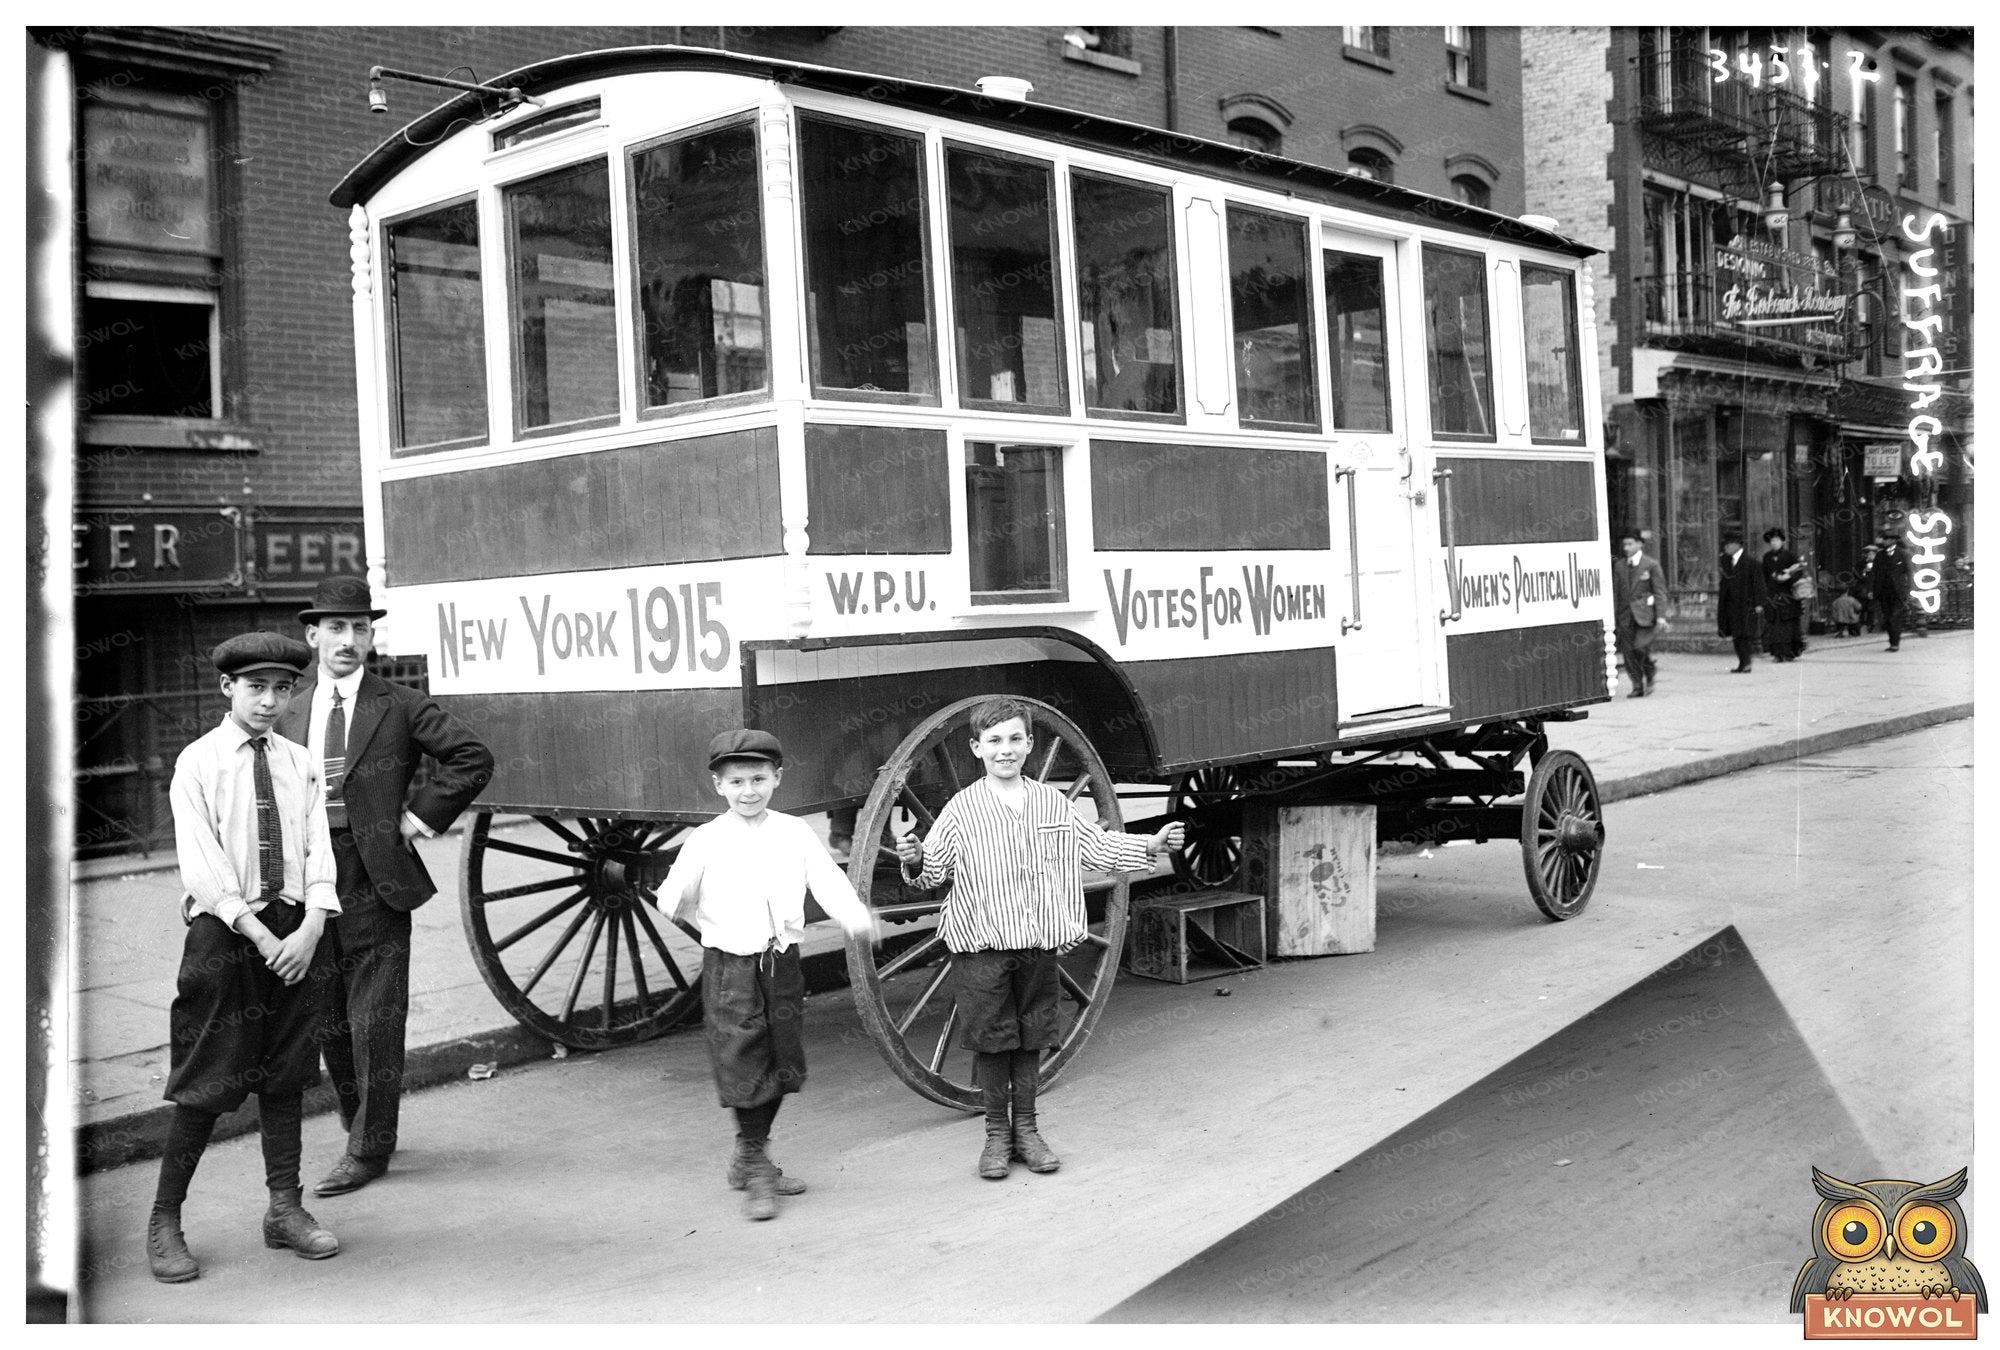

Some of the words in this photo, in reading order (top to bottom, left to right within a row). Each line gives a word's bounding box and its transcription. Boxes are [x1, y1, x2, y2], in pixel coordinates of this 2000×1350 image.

[825, 570, 936, 615] W.P.U.
[1103, 568, 1198, 647] VOTES
[1200, 566, 1243, 641] FOR
[1242, 564, 1326, 636] WOMEN
[1513, 555, 1568, 614] POLITICAL
[1568, 552, 1601, 610] UNION
[437, 602, 507, 678] NEW
[519, 594, 618, 676] YORK
[626, 581, 731, 674] 1915
